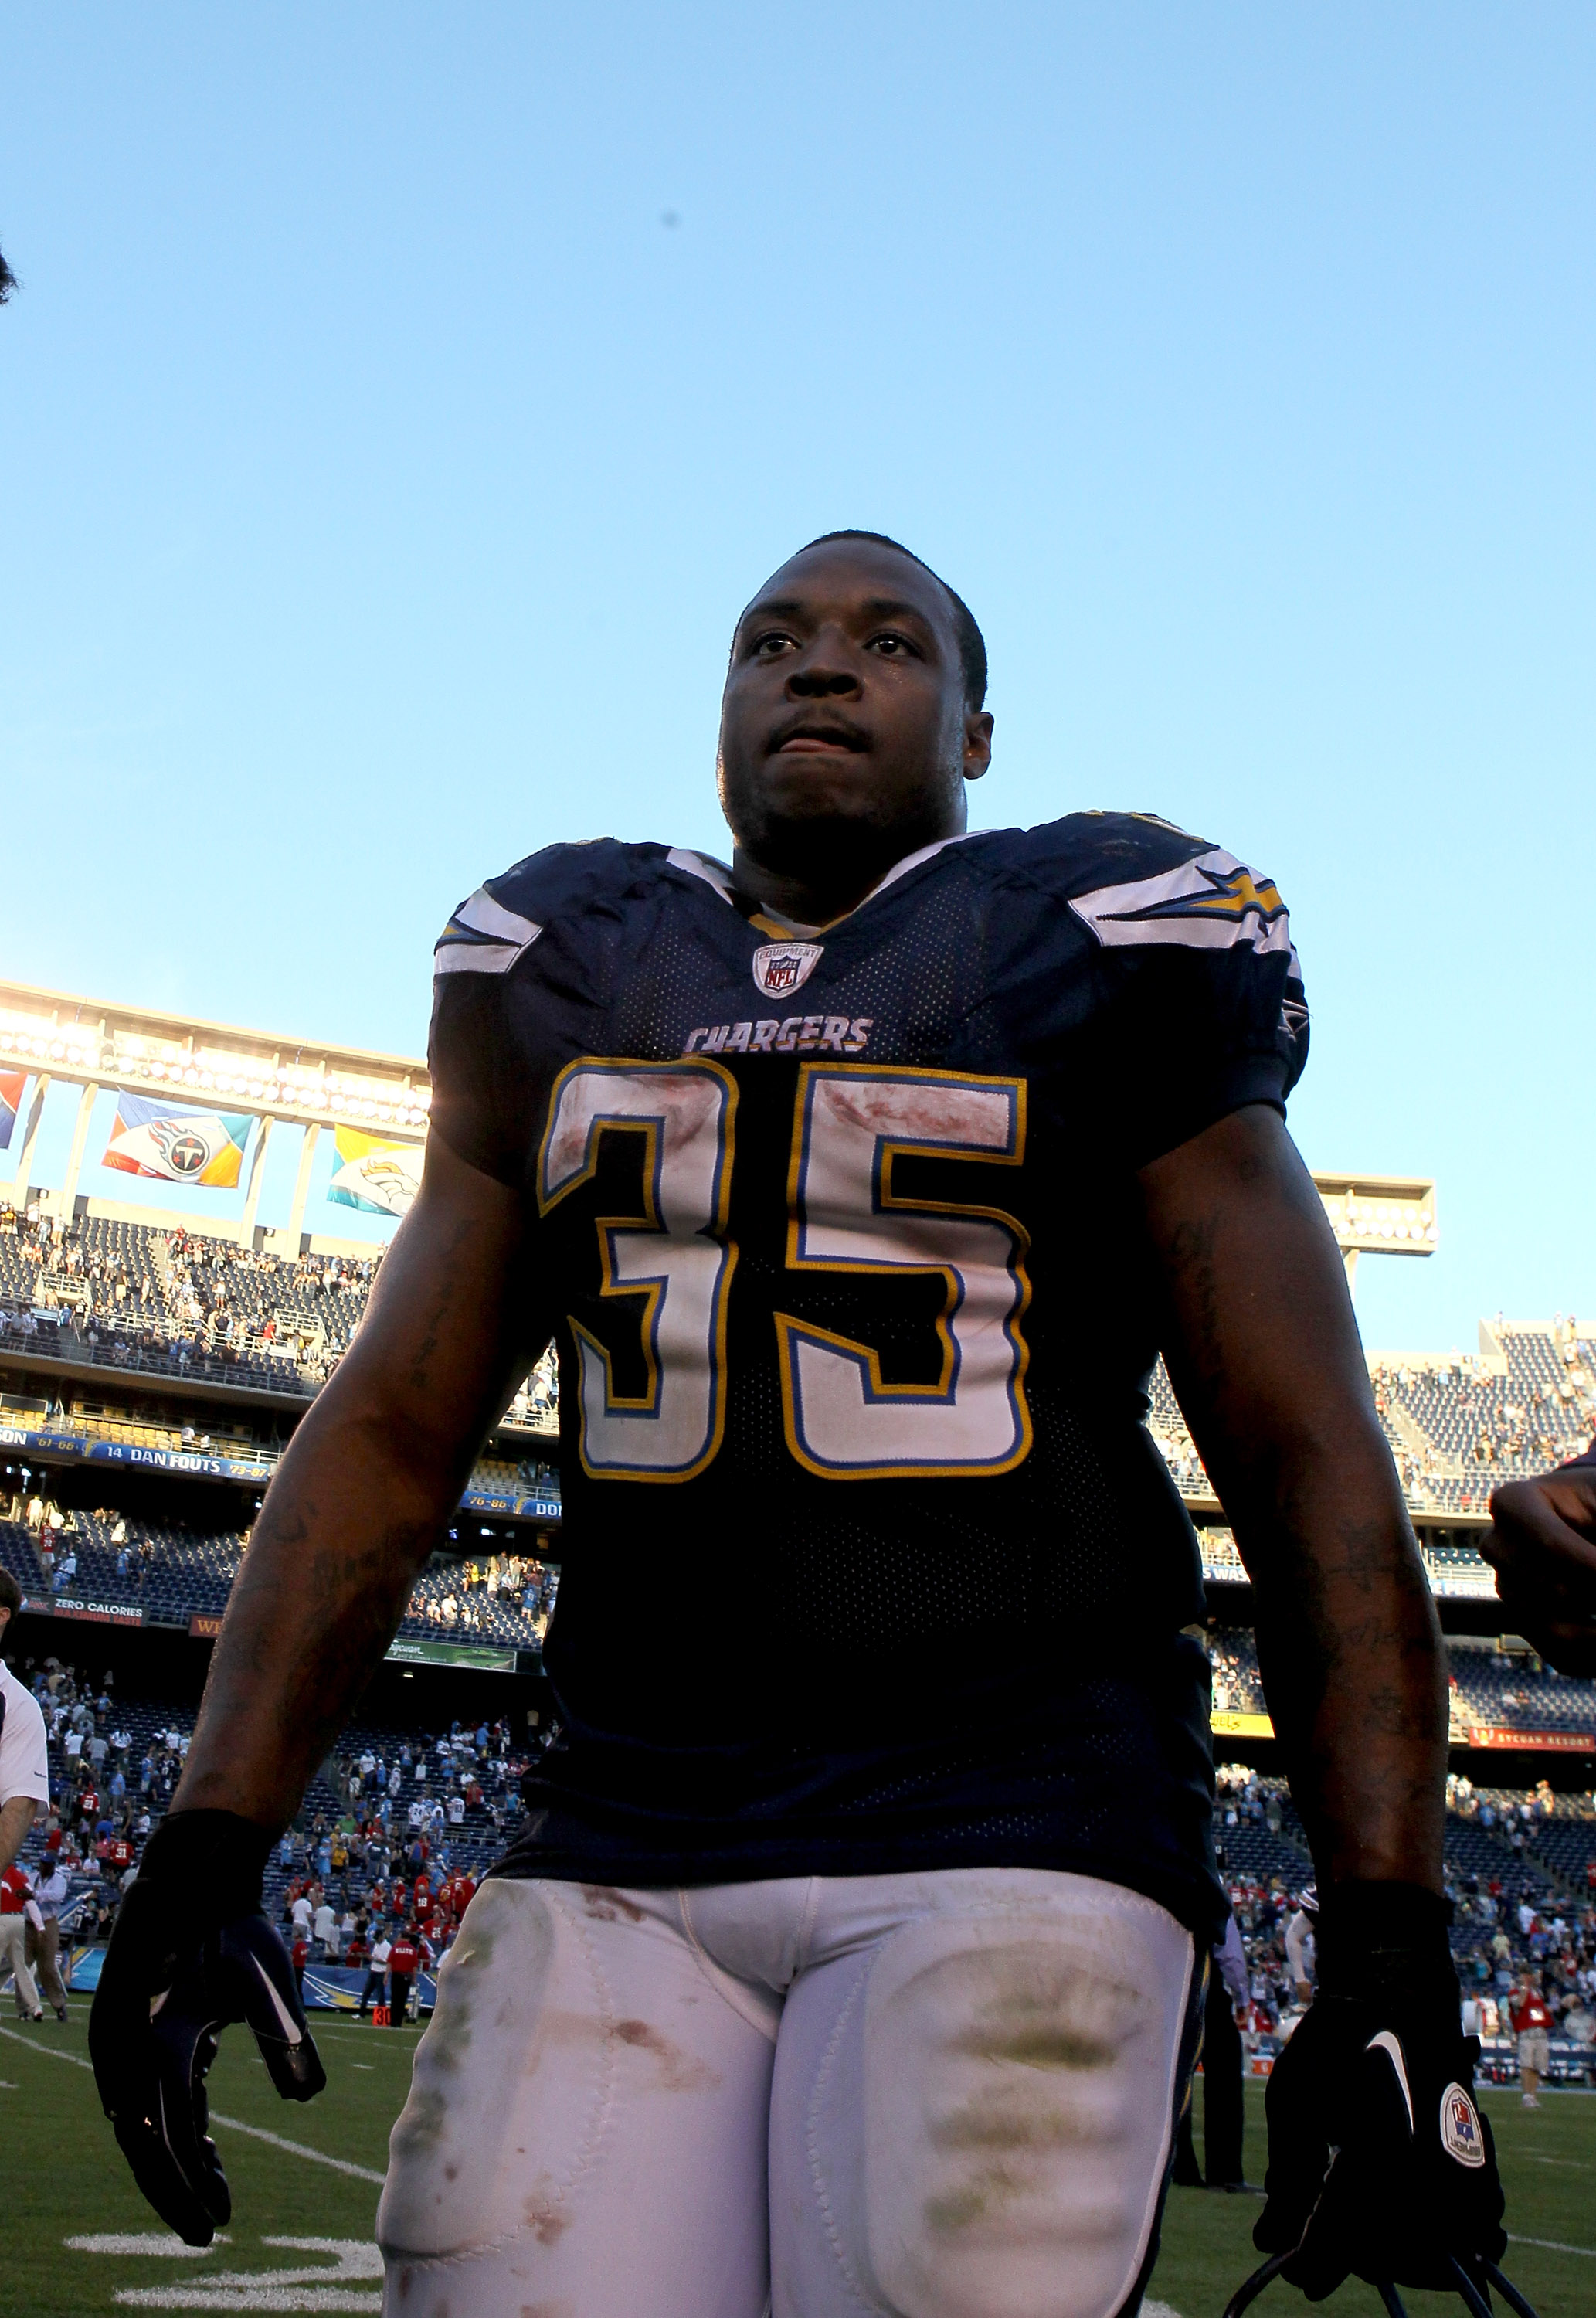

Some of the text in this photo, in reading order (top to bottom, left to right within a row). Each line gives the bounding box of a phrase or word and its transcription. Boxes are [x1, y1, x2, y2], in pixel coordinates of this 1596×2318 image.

[759, 947, 817, 960] EQUIPMENT
[767, 967, 795, 987] NFL
[683, 1015, 874, 1057] CHARGERS
[536, 1057, 1033, 1483] 35
[107, 1446, 123, 1459] 14
[131, 1449, 166, 1466] DAN
[169, 1455, 221, 1473] FOUTS
[55, 1598, 143, 1617] ZERO CALORIES
[376, 2007, 391, 2026] 30
